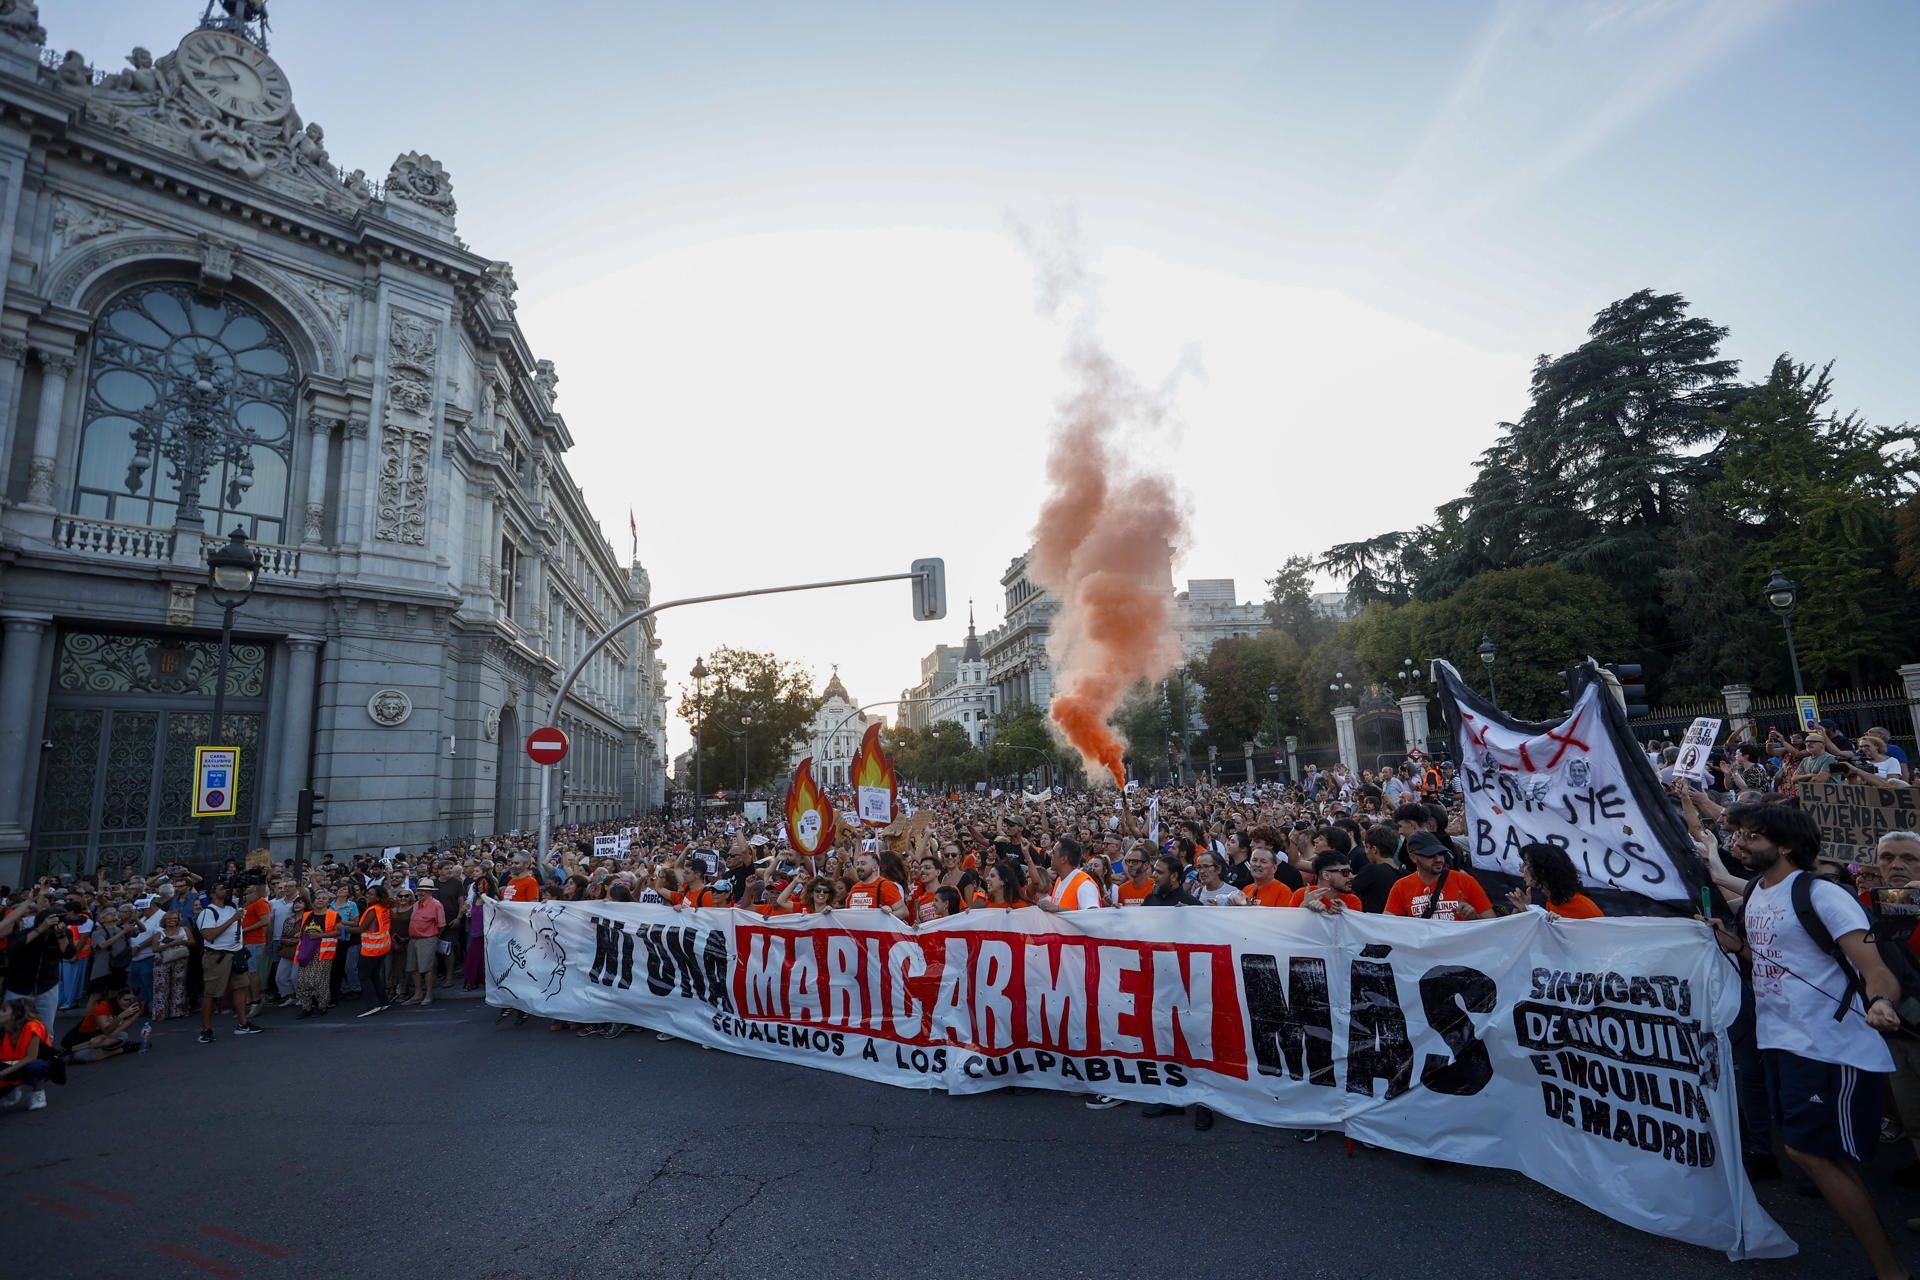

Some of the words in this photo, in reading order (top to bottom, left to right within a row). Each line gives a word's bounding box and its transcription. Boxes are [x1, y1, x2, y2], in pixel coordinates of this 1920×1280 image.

[1802, 784, 1822, 802] EL
[1824, 784, 1866, 806] PLAN
[1878, 788, 1916, 809] DE
[1821, 826, 1858, 845] EBE
[1895, 809, 1917, 829] NO
[588, 916, 635, 990] NI
[636, 923, 735, 1015] UNA
[746, 932, 1215, 1062] MARICARMEN
[1241, 943, 1498, 1101] MÁS
[1525, 1011, 1564, 1045] DE
[862, 1038, 880, 1063] A
[896, 1047, 947, 1074] LOS
[963, 1050, 1189, 1088] CULPABLES
[1529, 1054, 1558, 1078] E
[1555, 1051, 1710, 1123] INQUILIN
[1541, 1081, 1576, 1128] DE
[1579, 1095, 1716, 1169] MADRID
